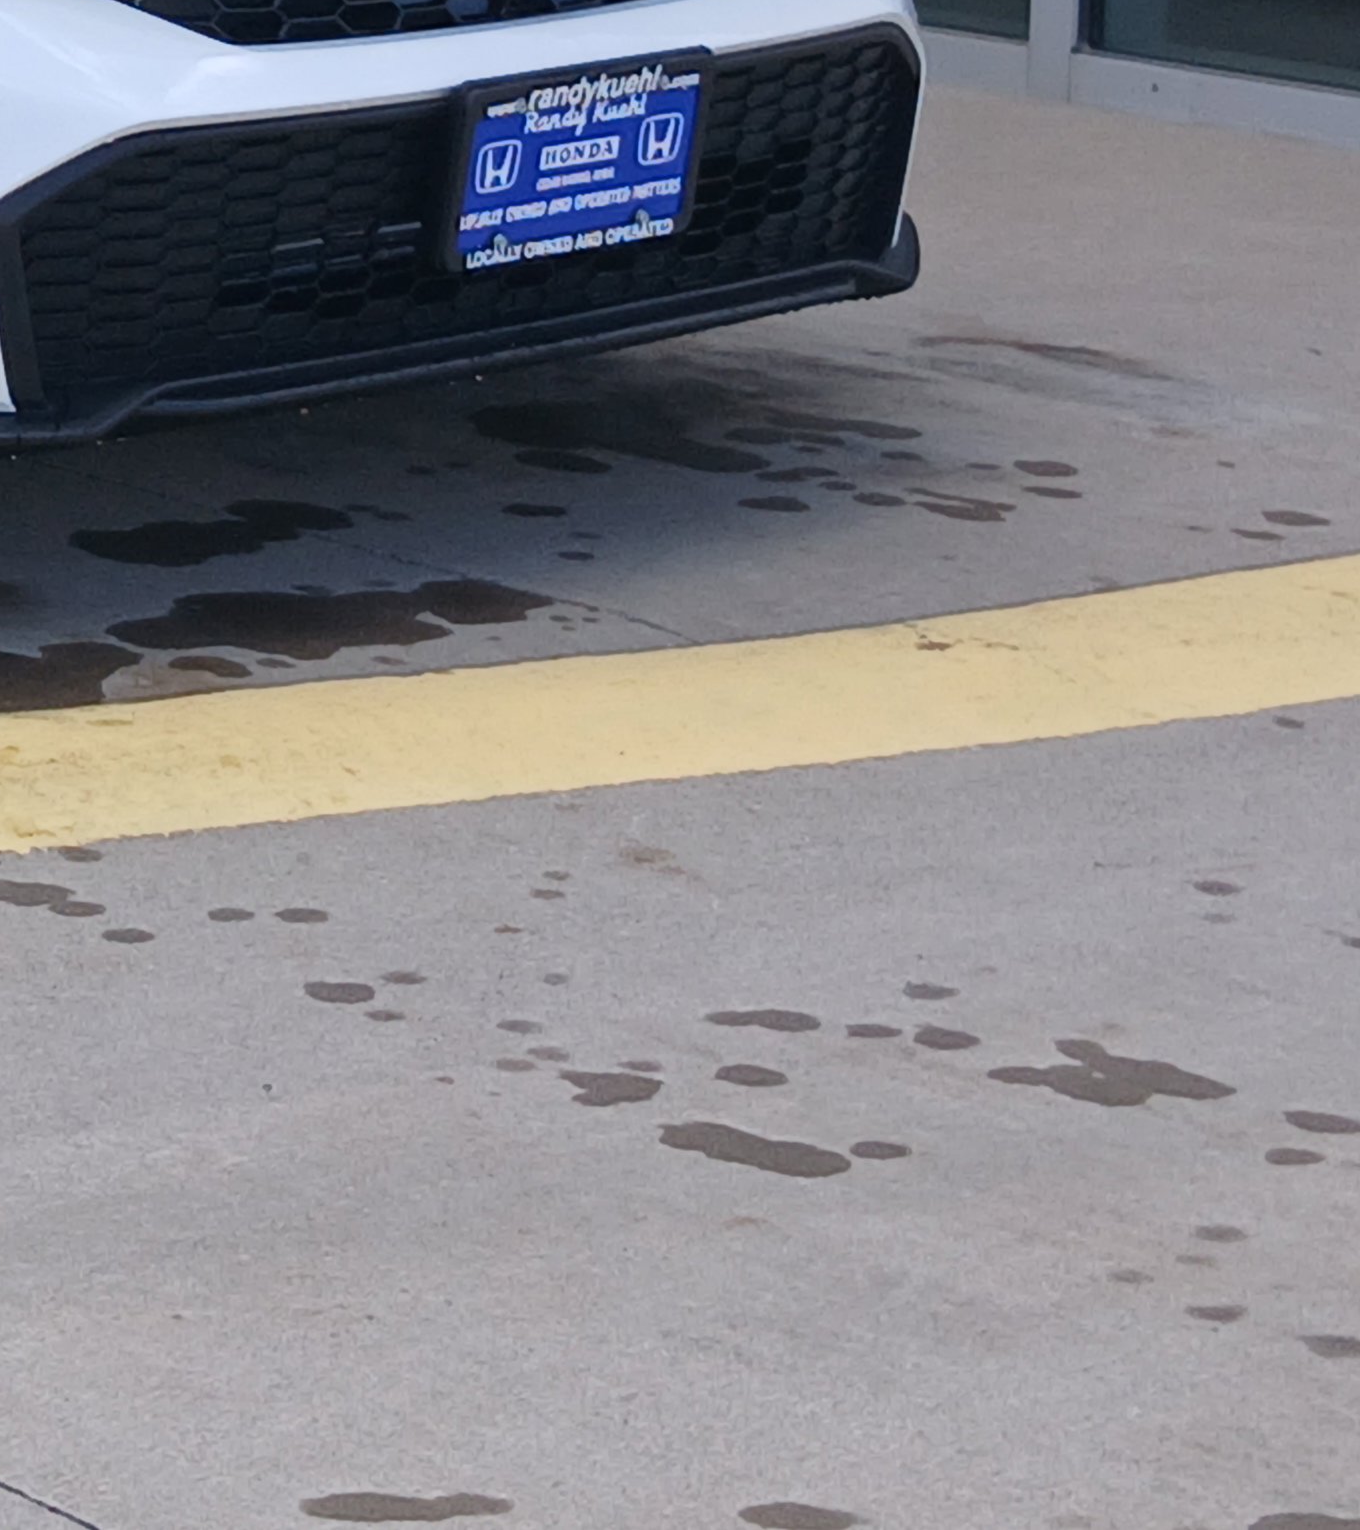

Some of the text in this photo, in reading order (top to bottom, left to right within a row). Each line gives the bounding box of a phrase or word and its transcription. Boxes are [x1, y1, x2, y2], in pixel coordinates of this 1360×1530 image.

[524, 104, 587, 137] Randy
[592, 92, 647, 123] Kuehl
[545, 140, 613, 165] HONDA
